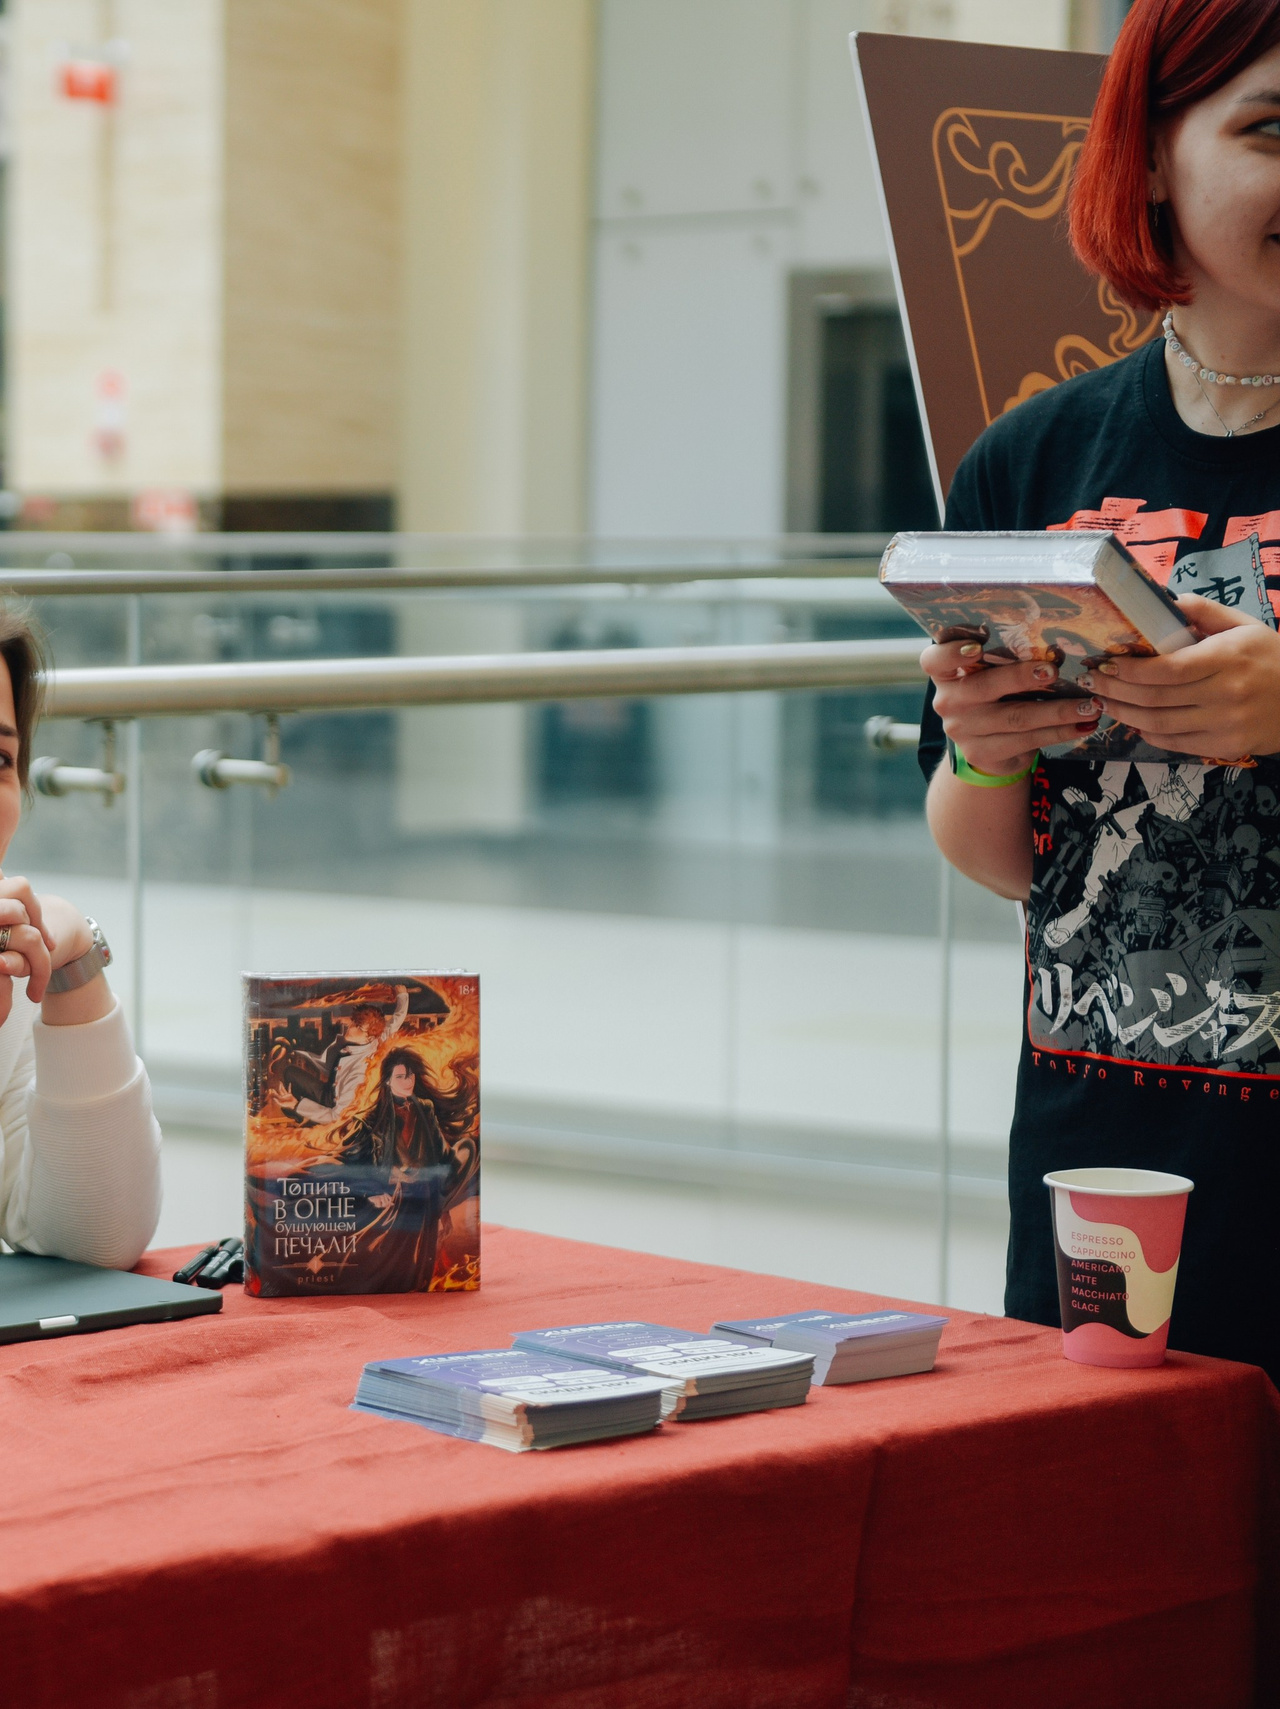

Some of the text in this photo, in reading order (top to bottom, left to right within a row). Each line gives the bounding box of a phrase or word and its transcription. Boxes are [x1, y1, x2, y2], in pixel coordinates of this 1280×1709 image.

[458, 984, 476, 996] 18+
[277, 1177, 351, 1196] Топить
[272, 1197, 356, 1220] В ОГНЕ
[275, 1220, 356, 1236] бушующем
[1071, 1231, 1124, 1246] ESPRESSO
[275, 1235, 357, 1258] ПЕЧАЛИ
[1071, 1245, 1136, 1260] CAPPUCCINO
[1071, 1259, 1132, 1274] AMERICANO
[297, 1274, 335, 1285] priest
[1071, 1272, 1098, 1286] LATTE
[1071, 1286, 1130, 1301] MACCHIATO
[1071, 1299, 1100, 1313] GLACE
